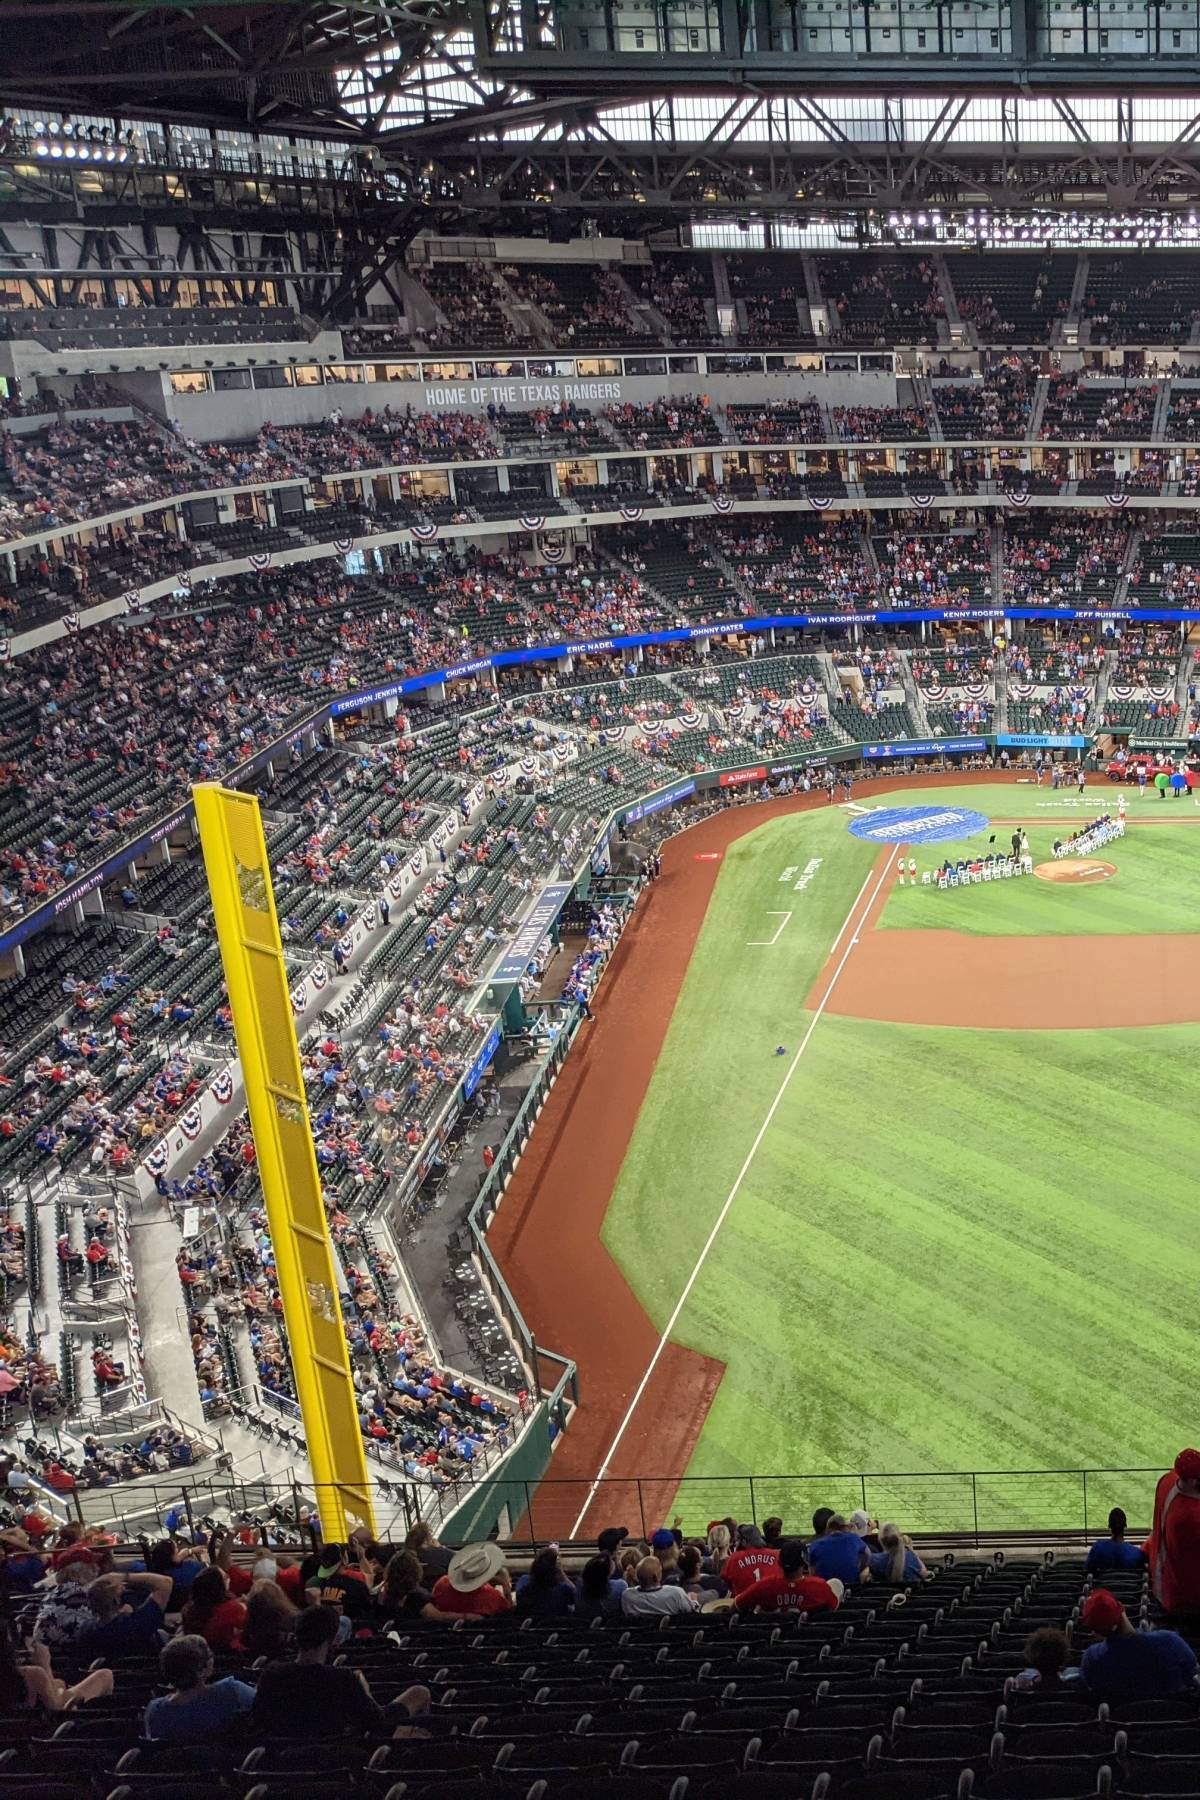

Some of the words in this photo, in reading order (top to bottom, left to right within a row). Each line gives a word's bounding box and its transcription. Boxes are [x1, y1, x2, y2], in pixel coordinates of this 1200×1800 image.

[426, 388, 467, 405] HOME
[470, 387, 488, 404] OF
[491, 386, 517, 402] THE
[519, 384, 560, 401] TEXAS
[564, 383, 621, 400] RANGERS
[943, 611, 970, 619] KENNY
[972, 609, 1005, 618] ROGERS
[1074, 611, 1094, 619] JEFF
[1095, 611, 1132, 619] RUSSELL
[689, 627, 720, 637] JOHNNY
[721, 623, 745, 633] OATES
[566, 645, 586, 654] ERIC
[587, 641, 616, 652] NADEL
[445, 666, 467, 679] CHUCK
[467, 659, 492, 673] MORGAN
[337, 696, 373, 712] FERGUSON
[1026, 737, 1048, 745] LIGHT
[1153, 741, 1163, 749] City
[55, 896, 72, 914] JOSH
[71, 872, 105, 901] HAMILTON
[527, 904, 557, 926] TEXAS
[507, 926, 544, 958] RANGERS
[738, 1554, 776, 1569] ANDRUS
[753, 1568, 761, 1582] 1
[777, 1594, 804, 1606] ODOR
